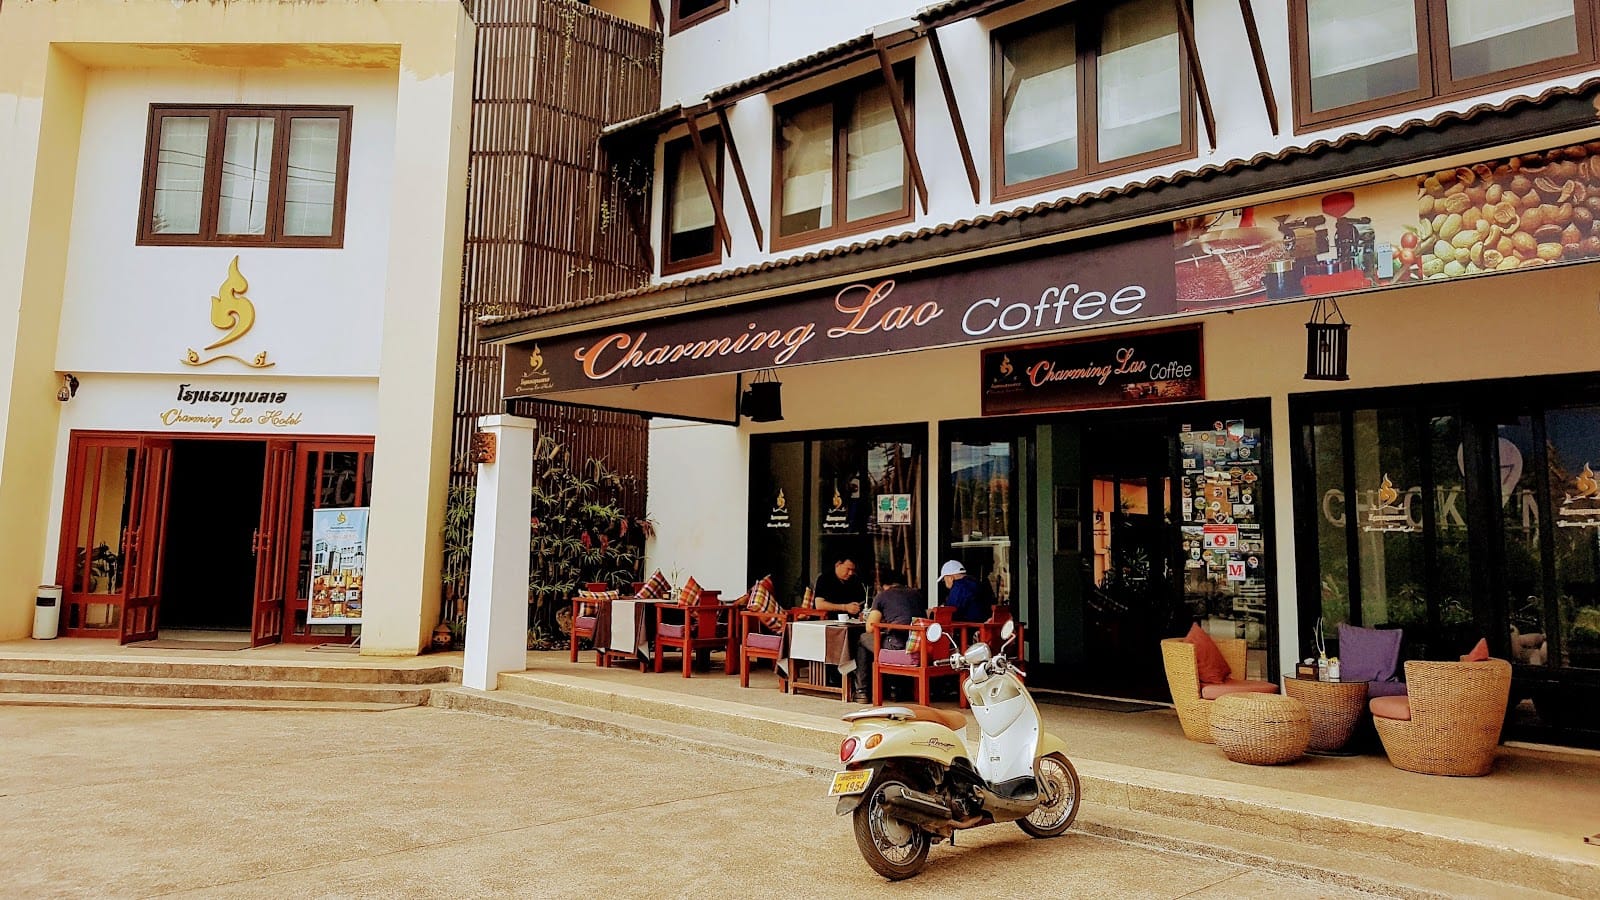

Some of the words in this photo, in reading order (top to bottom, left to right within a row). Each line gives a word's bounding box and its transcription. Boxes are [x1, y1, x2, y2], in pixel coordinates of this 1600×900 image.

[574, 322, 816, 379] Charming
[827, 279, 945, 338] Lao
[961, 283, 1147, 335] Coffee
[1026, 361, 1112, 387] Charming
[1114, 348, 1147, 374] Lao
[1150, 360, 1193, 380] Coffee
[160, 408, 222, 428] Charming
[228, 407, 253, 424] Lao
[258, 410, 302, 427] Hotel
